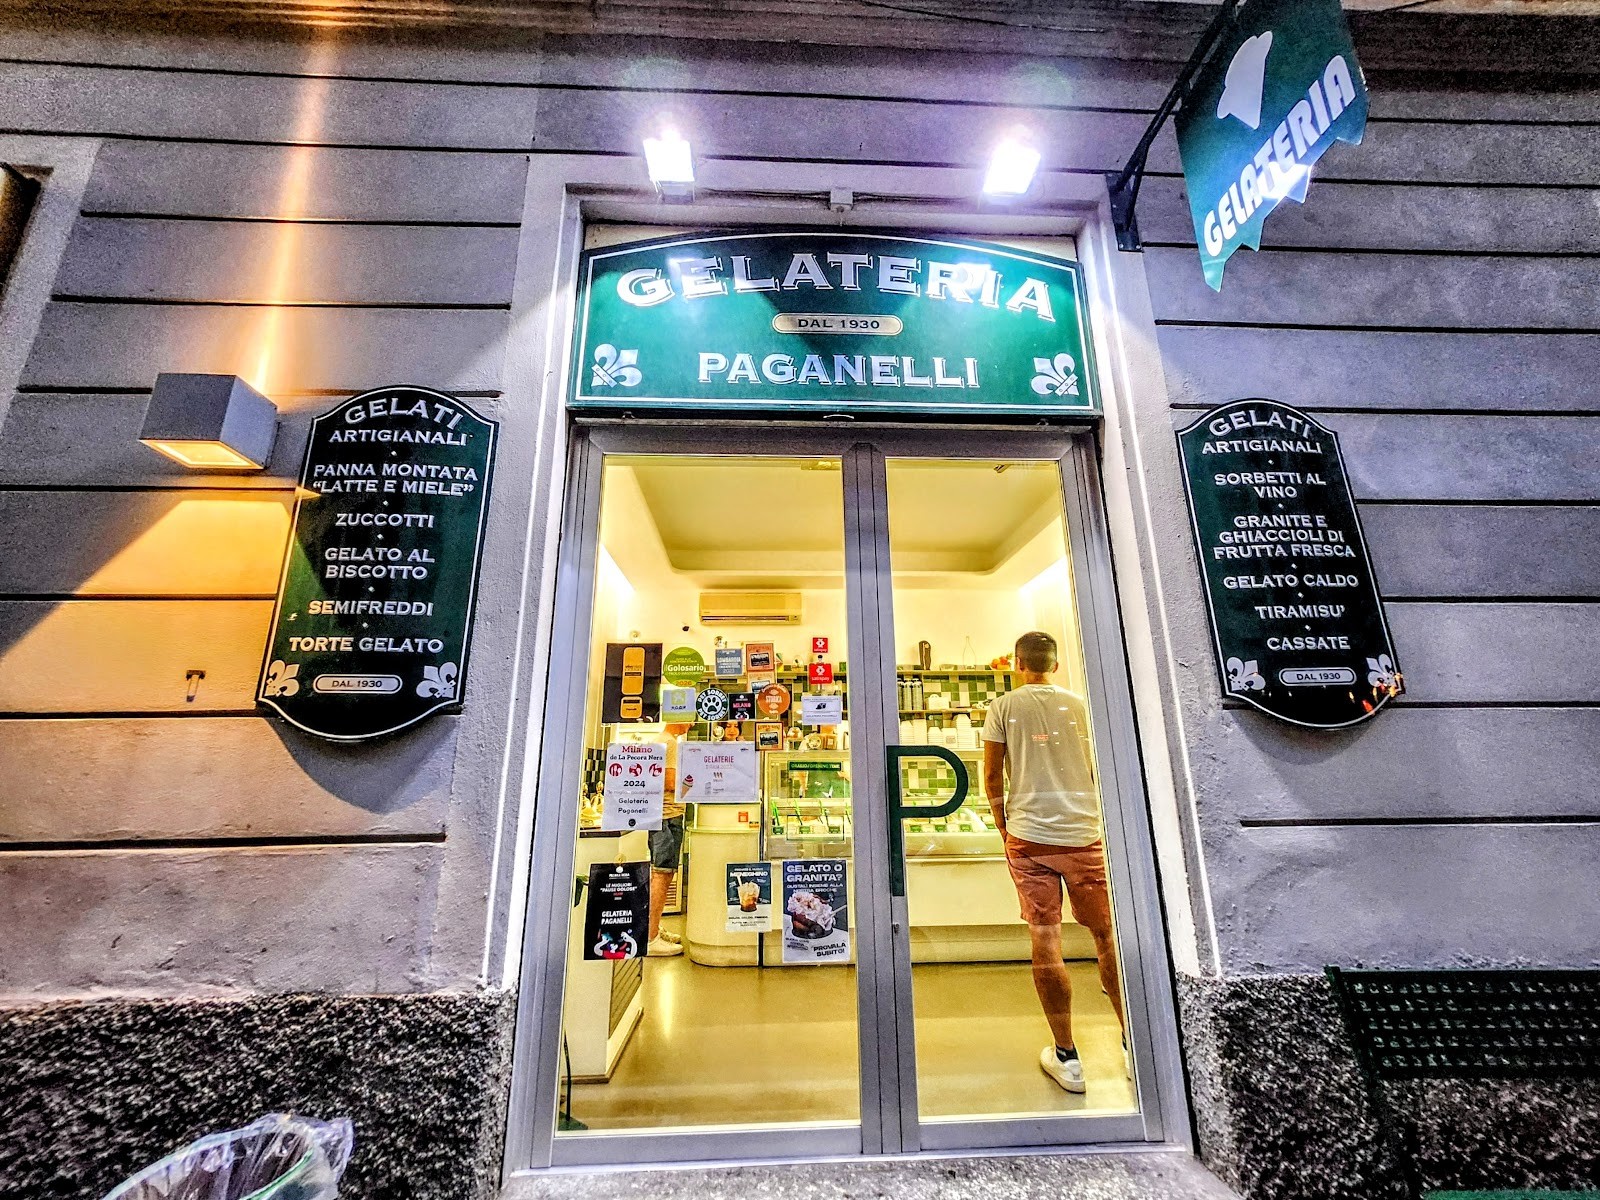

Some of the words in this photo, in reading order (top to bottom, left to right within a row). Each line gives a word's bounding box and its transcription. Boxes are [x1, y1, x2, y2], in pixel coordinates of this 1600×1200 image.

[1204, 55, 1356, 256] GELATERIA
[616, 252, 1055, 322] GELATERIA
[797, 318, 833, 330] DAL
[840, 319, 880, 331] 1930
[698, 352, 981, 389] PAGANELLI
[345, 398, 463, 430] GELATI
[1209, 410, 1312, 438] GELATI
[329, 430, 467, 446] ARTIGIANALI
[1202, 440, 1322, 455] ARTIGIANALI
[314, 464, 376, 477] PANNA
[382, 464, 478, 481] MONTATA
[1214, 472, 1302, 486] SORBETTI
[1306, 473, 1326, 485] AL
[313, 479, 378, 493] "LATTE
[384, 480, 396, 493] E
[402, 481, 474, 497] MIELE"
[1253, 486, 1297, 498] VINO
[335, 513, 435, 528] ZUCCOTTI
[1233, 515, 1312, 528] GRANITE
[1315, 516, 1328, 528] E
[1219, 530, 1324, 544] GHIACCIOLI
[1327, 531, 1345, 543] DI
[324, 547, 402, 562] GELATO
[407, 548, 435, 563] AL
[1213, 544, 1288, 559] FRUTTA
[1291, 544, 1356, 558] FRESCA
[325, 565, 428, 580] BISCOTTO
[1223, 574, 1299, 589] GELATO
[1303, 574, 1359, 587] CALDO
[308, 600, 434, 616] SEMIFREDDI
[1254, 605, 1346, 619] TIRAMISU'
[289, 637, 353, 652] TORTE
[359, 637, 444, 654] GELATO
[1266, 636, 1351, 651] CASSATE
[331, 680, 353, 688] DAL
[357, 680, 382, 688] 1930
[1296, 673, 1316, 681] DAL
[1319, 672, 1341, 680] 1930
[703, 755, 735, 763] GELATERIE
[623, 780, 646, 788] 2024
[886, 745, 969, 896] P
[786, 864, 831, 872] GELATO
[834, 864, 842, 872] O
[786, 873, 843, 882] GRANITA?
[601, 910, 633, 918] GELATERIA
[601, 916, 633, 925] PAGANELLI
